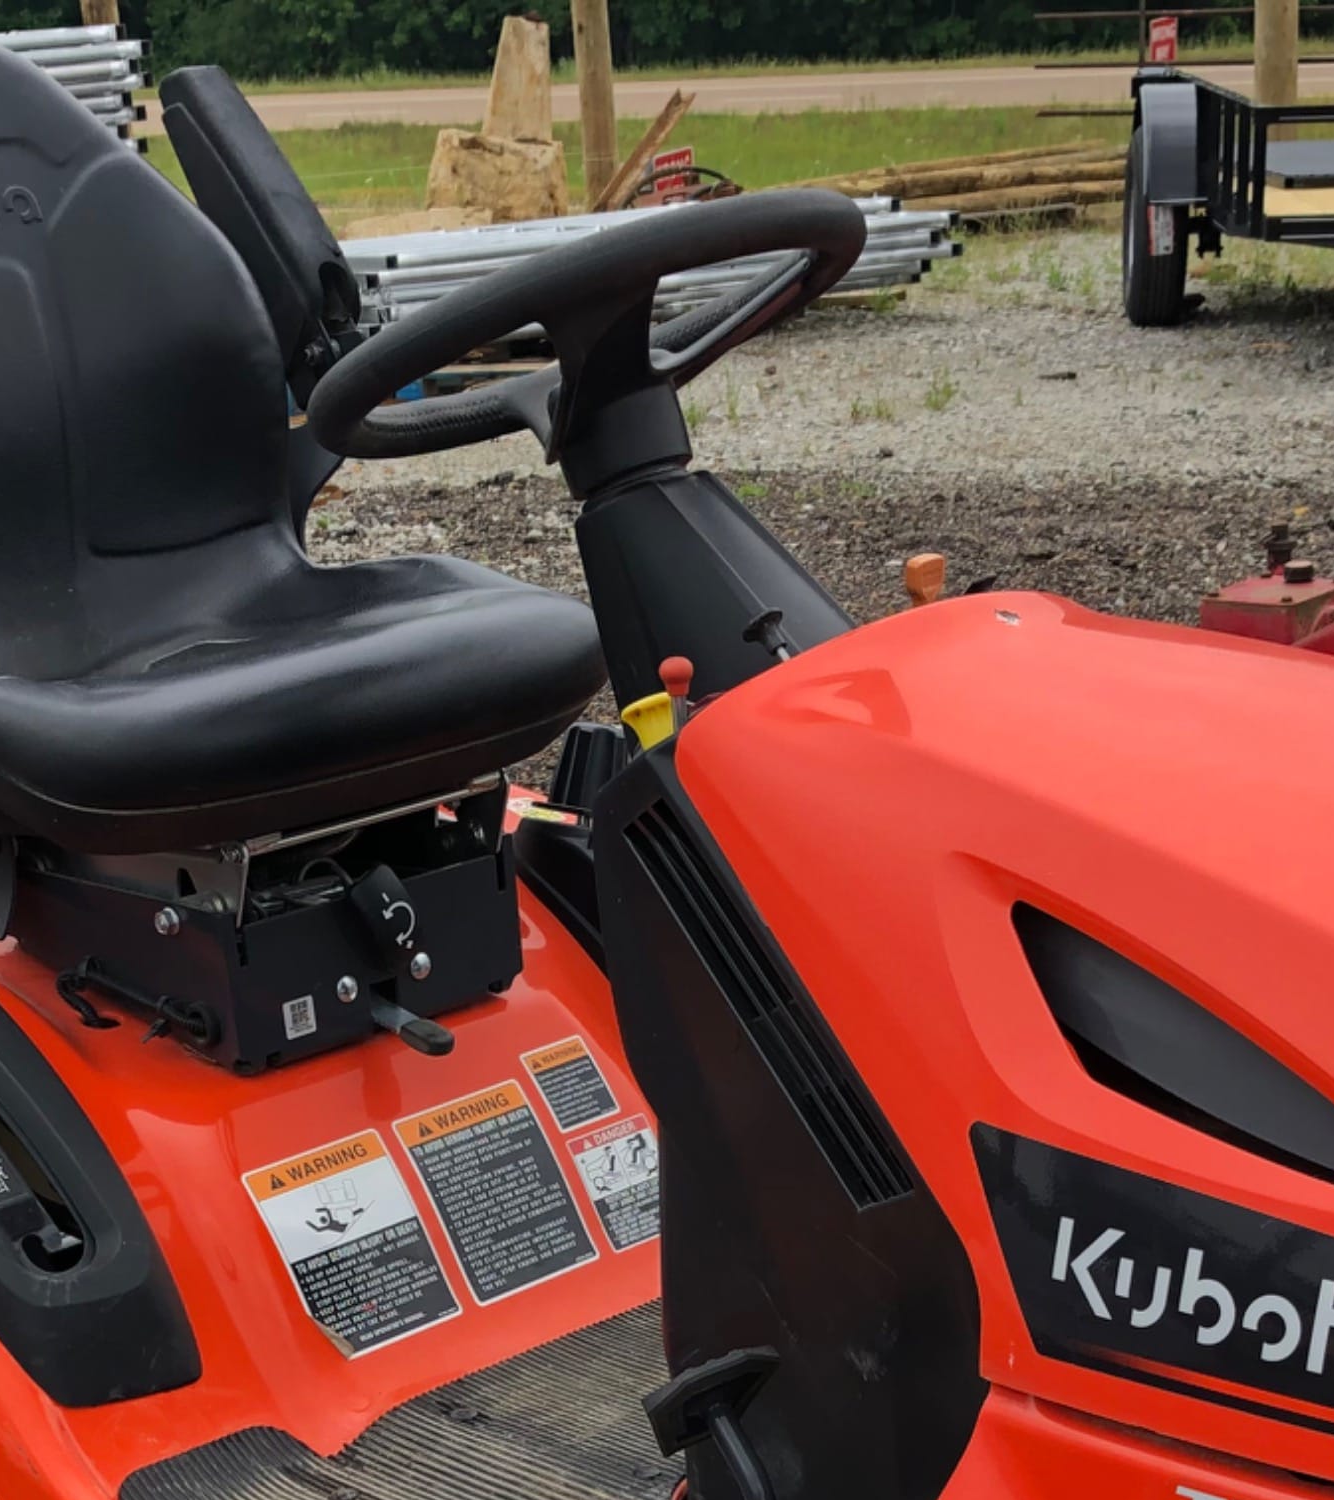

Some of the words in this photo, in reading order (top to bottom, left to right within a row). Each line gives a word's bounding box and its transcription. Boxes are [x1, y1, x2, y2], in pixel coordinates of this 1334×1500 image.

[432, 1091, 510, 1131] WARNING
[593, 1122, 636, 1145] DANGER
[285, 1142, 368, 1182] WARNING
